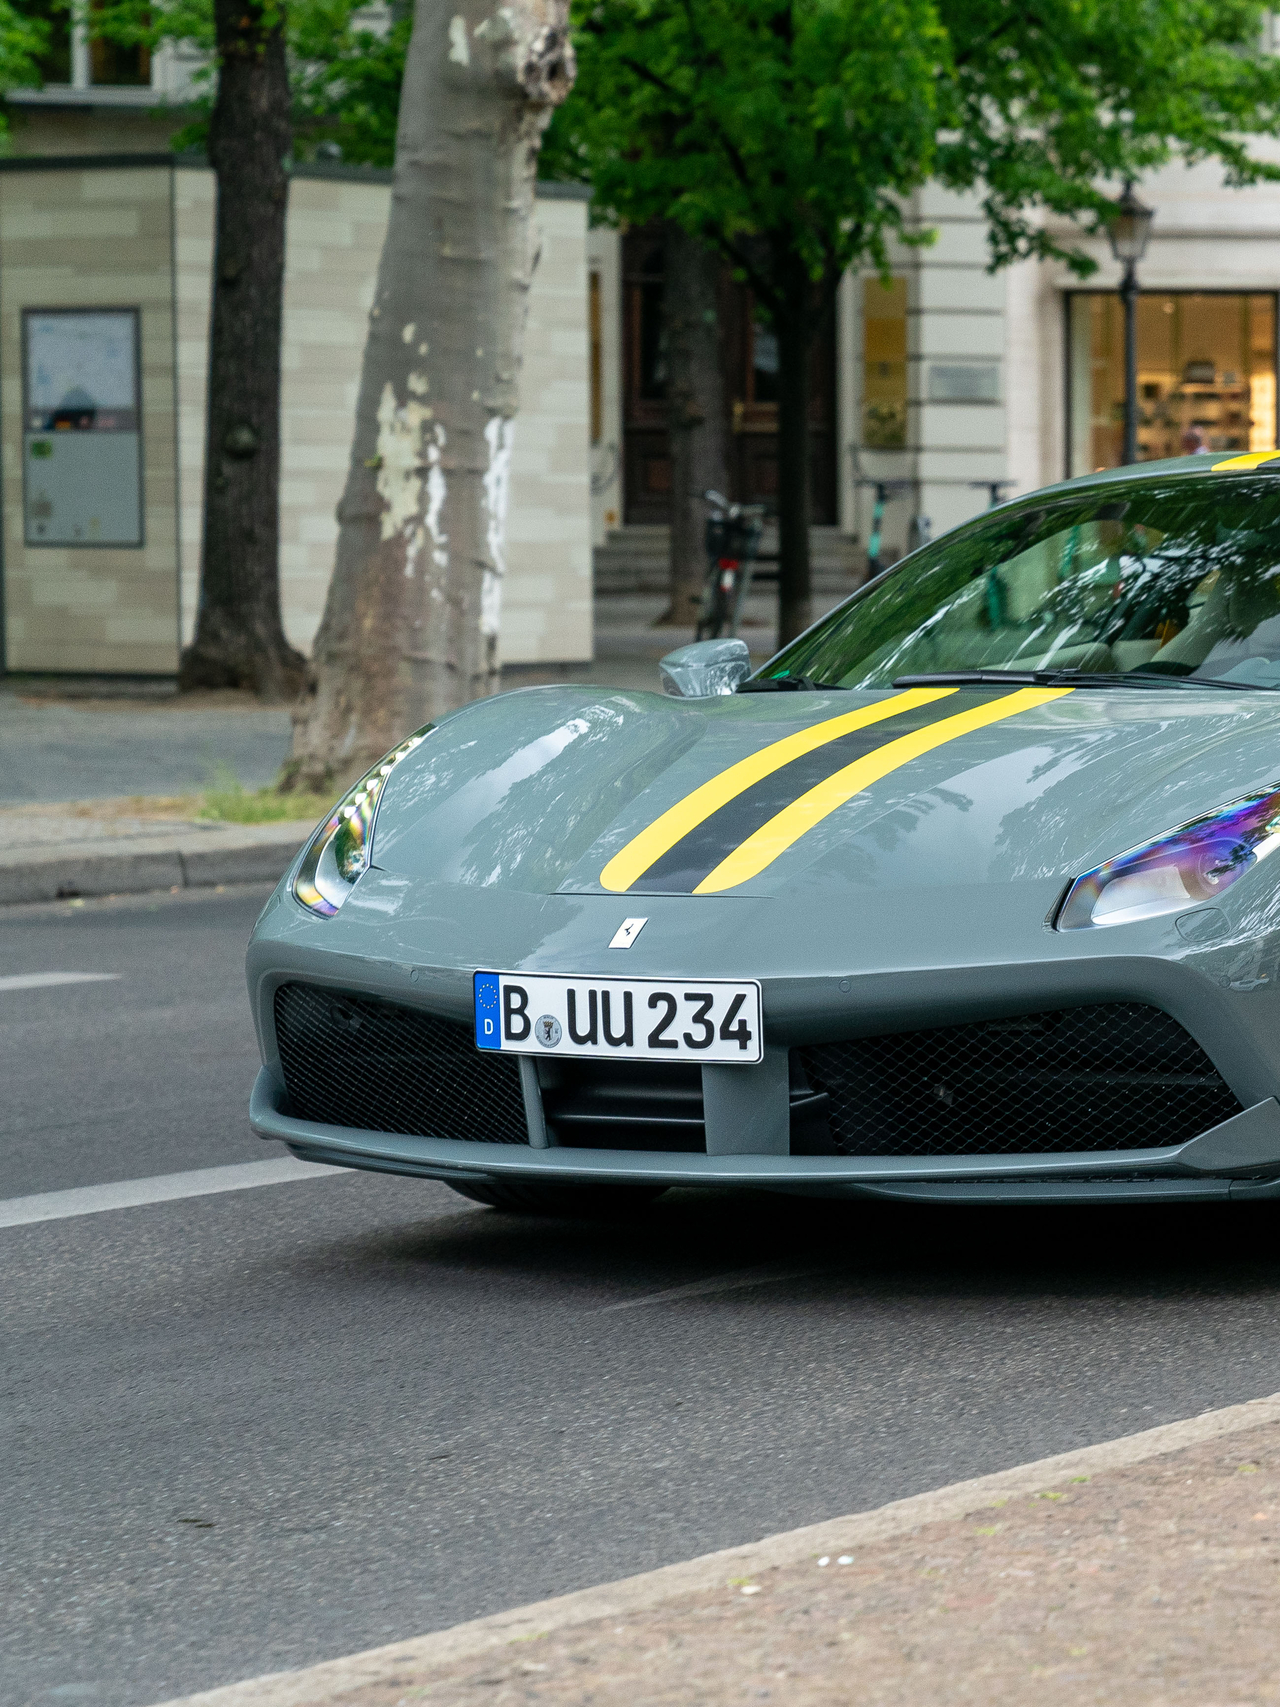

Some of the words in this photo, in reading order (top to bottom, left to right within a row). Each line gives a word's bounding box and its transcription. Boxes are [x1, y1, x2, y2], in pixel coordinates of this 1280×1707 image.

[484, 1018, 494, 1035] D
[504, 984, 532, 1041] B
[567, 988, 633, 1047] UU
[647, 992, 752, 1050] 234
